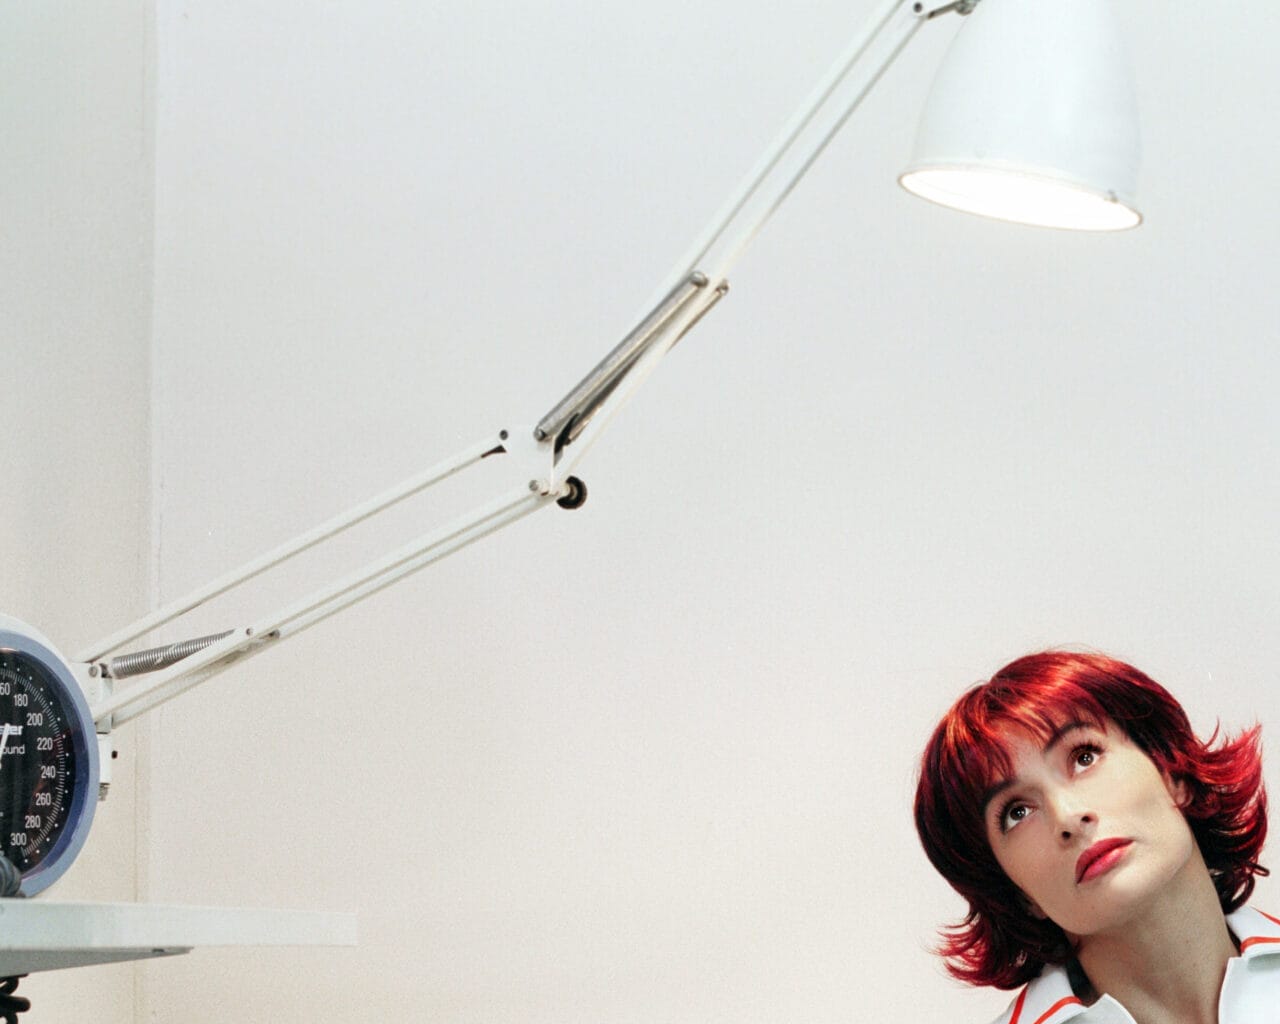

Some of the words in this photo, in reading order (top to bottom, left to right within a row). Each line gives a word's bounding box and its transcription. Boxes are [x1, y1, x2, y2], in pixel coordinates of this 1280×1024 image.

[14, 694, 28, 706] 180
[26, 712, 43, 726] 200
[37, 737, 53, 750] 220
[41, 765, 56, 778] 240
[36, 793, 51, 806] 260
[25, 815, 41, 828] 280
[10, 833, 27, 846] 300
